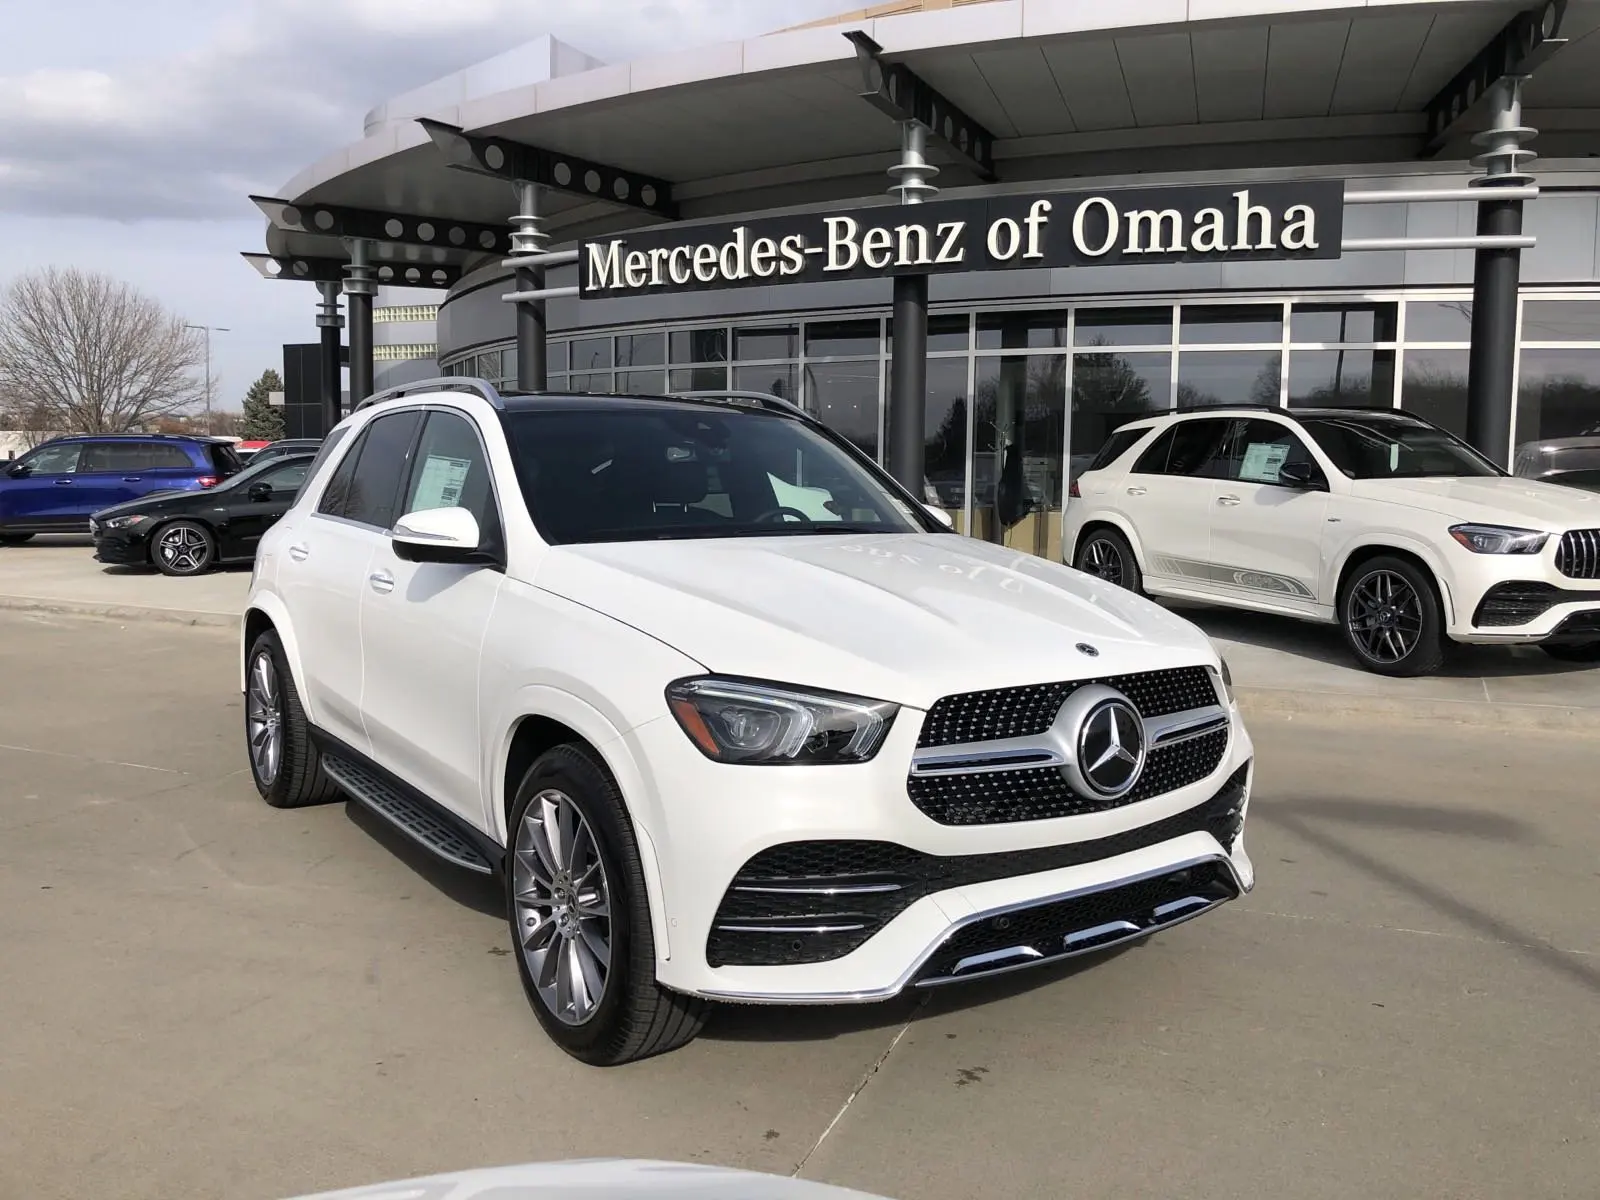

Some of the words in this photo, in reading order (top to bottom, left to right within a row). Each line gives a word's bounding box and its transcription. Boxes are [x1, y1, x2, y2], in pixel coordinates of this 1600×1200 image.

[584, 216, 966, 291] Mercedes-Benz
[987, 199, 1052, 261] of
[1072, 190, 1319, 257] Omaha
